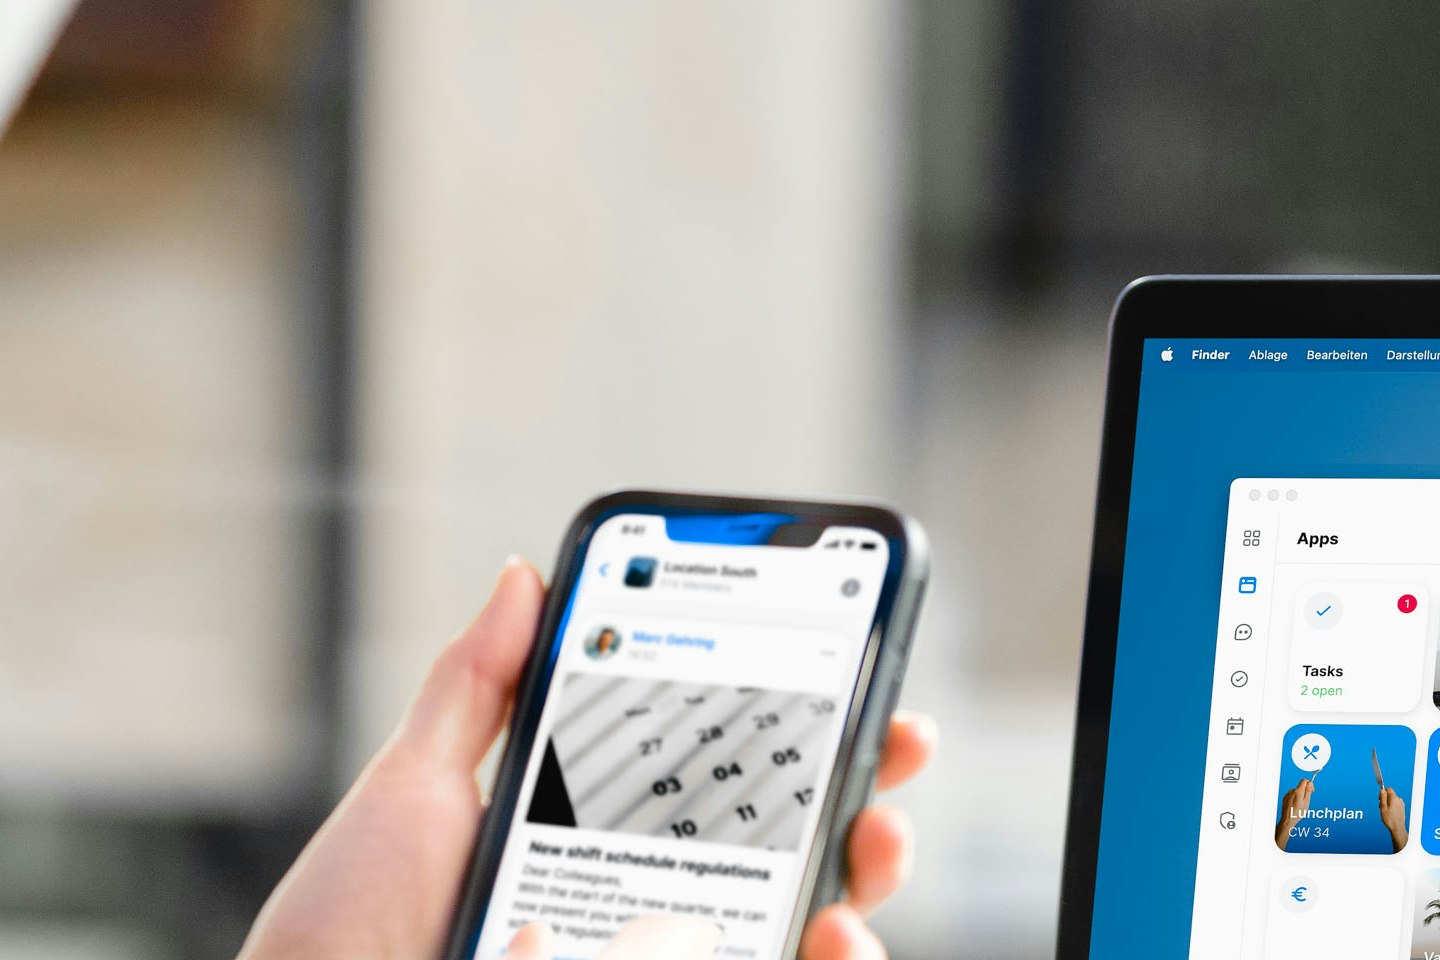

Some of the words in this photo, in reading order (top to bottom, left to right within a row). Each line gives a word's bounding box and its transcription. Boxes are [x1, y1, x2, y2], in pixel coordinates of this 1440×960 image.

[1192, 349, 1230, 359] Finder
[1249, 350, 1287, 361] Ablage
[1307, 350, 1367, 360] Bearbeiten
[1297, 532, 1338, 548] Apps
[1404, 599, 1410, 609] 1
[1303, 665, 1343, 677] Tasks
[1301, 685, 1308, 695] 2
[1312, 688, 1343, 698] open
[696, 727, 723, 744] 28
[652, 777, 682, 796] 03
[712, 763, 743, 781] 04
[771, 748, 801, 766] 05
[1289, 806, 1364, 821] Lunchplan
[671, 820, 698, 838] 10
[736, 804, 758, 822] 11
[1288, 827, 1311, 838] CW
[1313, 827, 1330, 838] 34
[528, 841, 561, 856] New
[567, 846, 601, 862] shift
[606, 851, 676, 870] schedule
[680, 858, 771, 880] regulations
